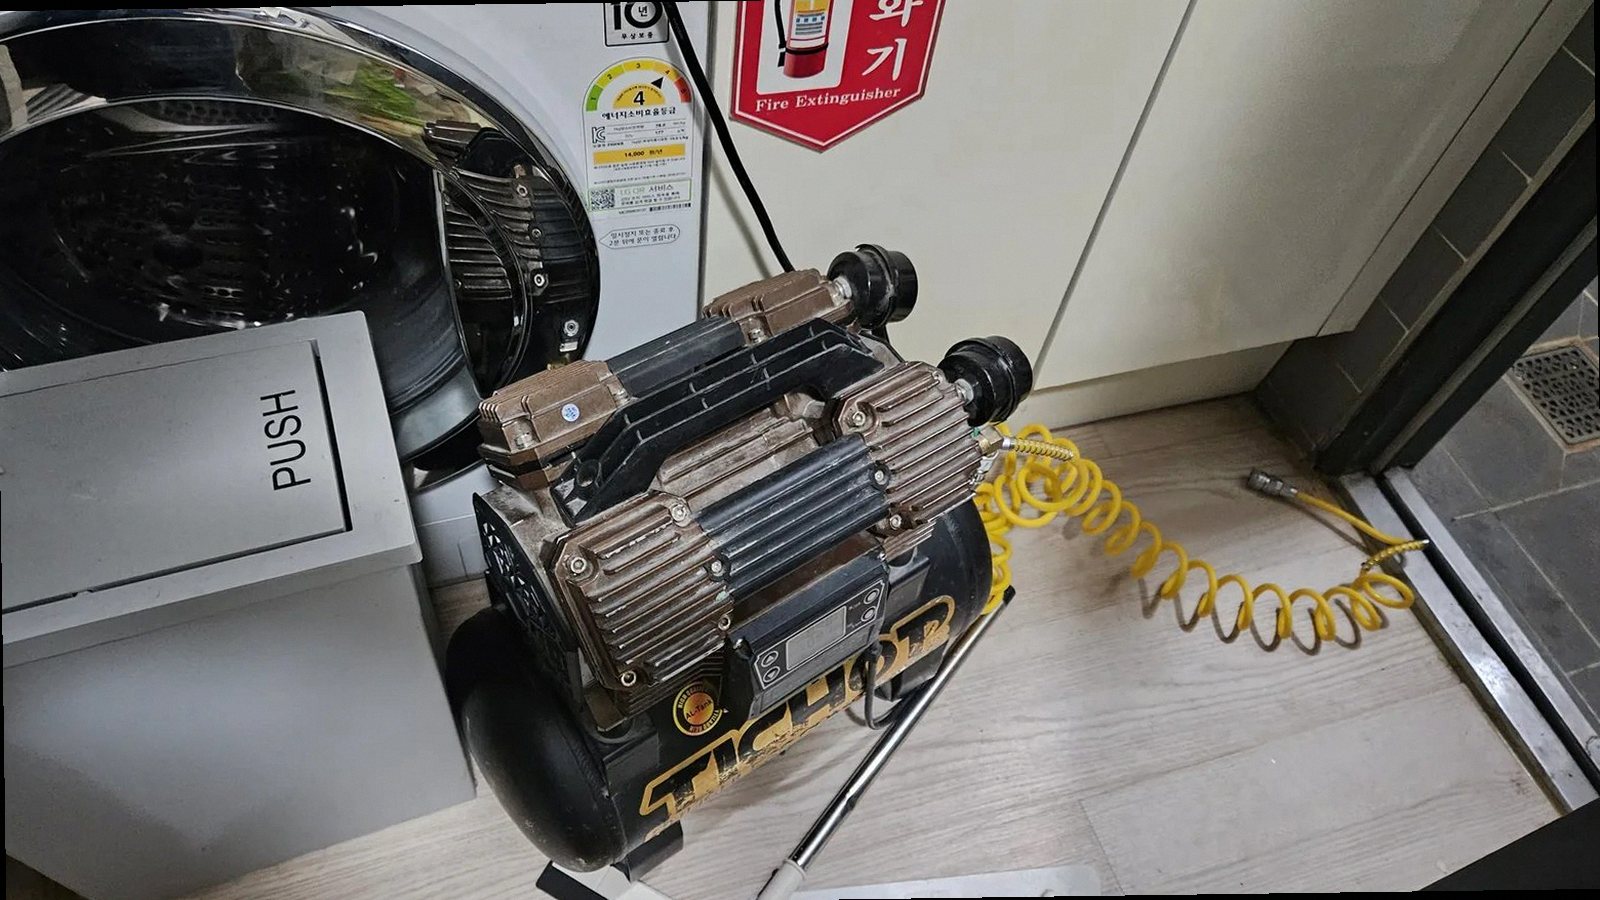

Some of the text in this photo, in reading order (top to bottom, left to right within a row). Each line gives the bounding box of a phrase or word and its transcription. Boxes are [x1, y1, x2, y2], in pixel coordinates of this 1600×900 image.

[638, 6, 648, 17] 년
[633, 91, 645, 105] 4
[755, 87, 901, 113] Fire Extinguisher
[601, 106, 676, 120] 에너지소비효율등급
[624, 150, 645, 158] 14,000
[648, 184, 673, 192] 서비스
[260, 389, 312, 491] PUSH
[686, 699, 712, 719] AL-Tank
